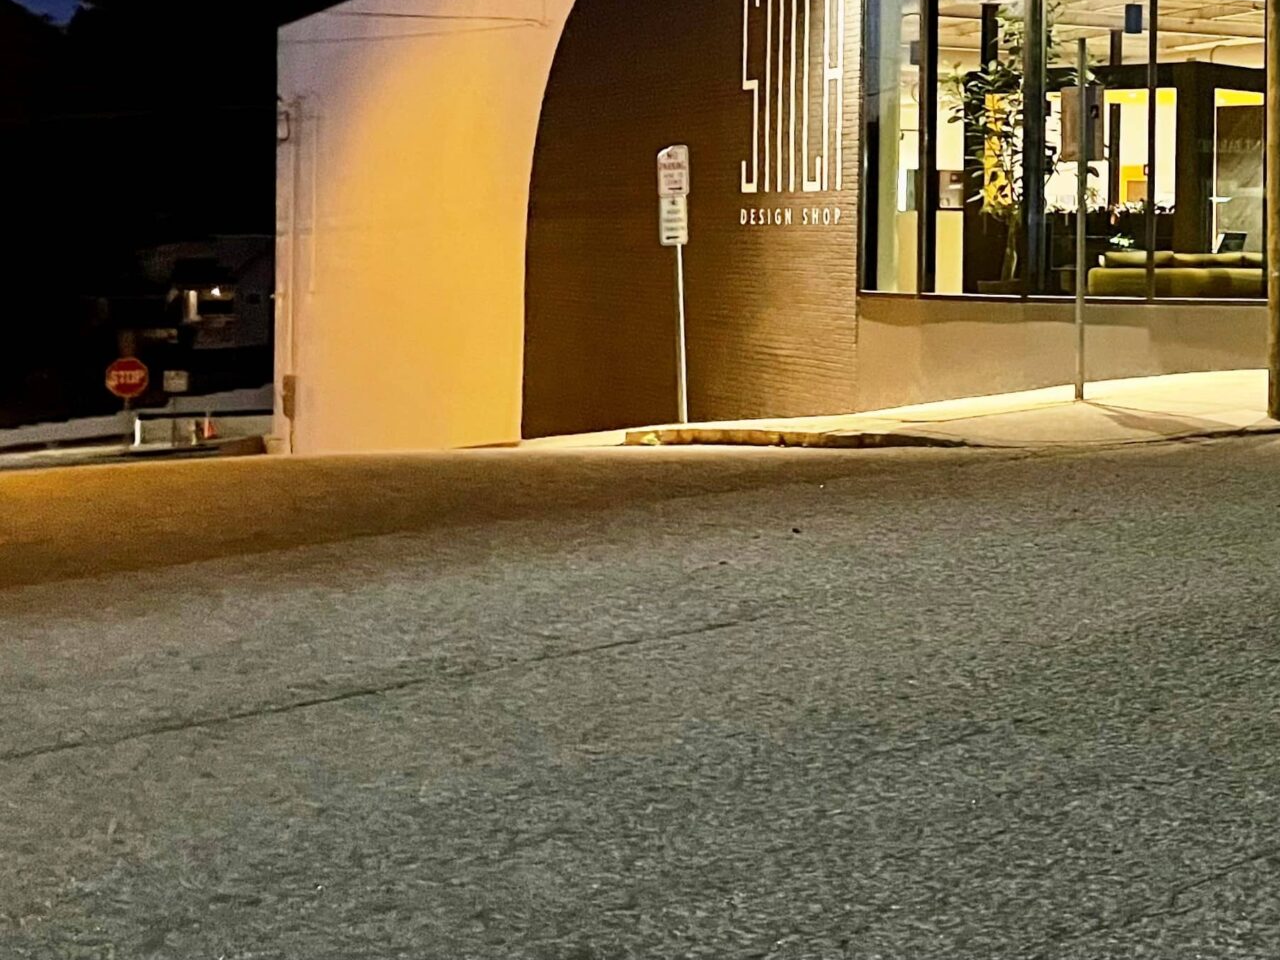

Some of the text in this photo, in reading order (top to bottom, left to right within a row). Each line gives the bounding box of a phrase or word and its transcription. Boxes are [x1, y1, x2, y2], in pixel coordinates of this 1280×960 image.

[740, 207, 842, 225] DESIGN SHOP
[107, 370, 145, 386] STOP
